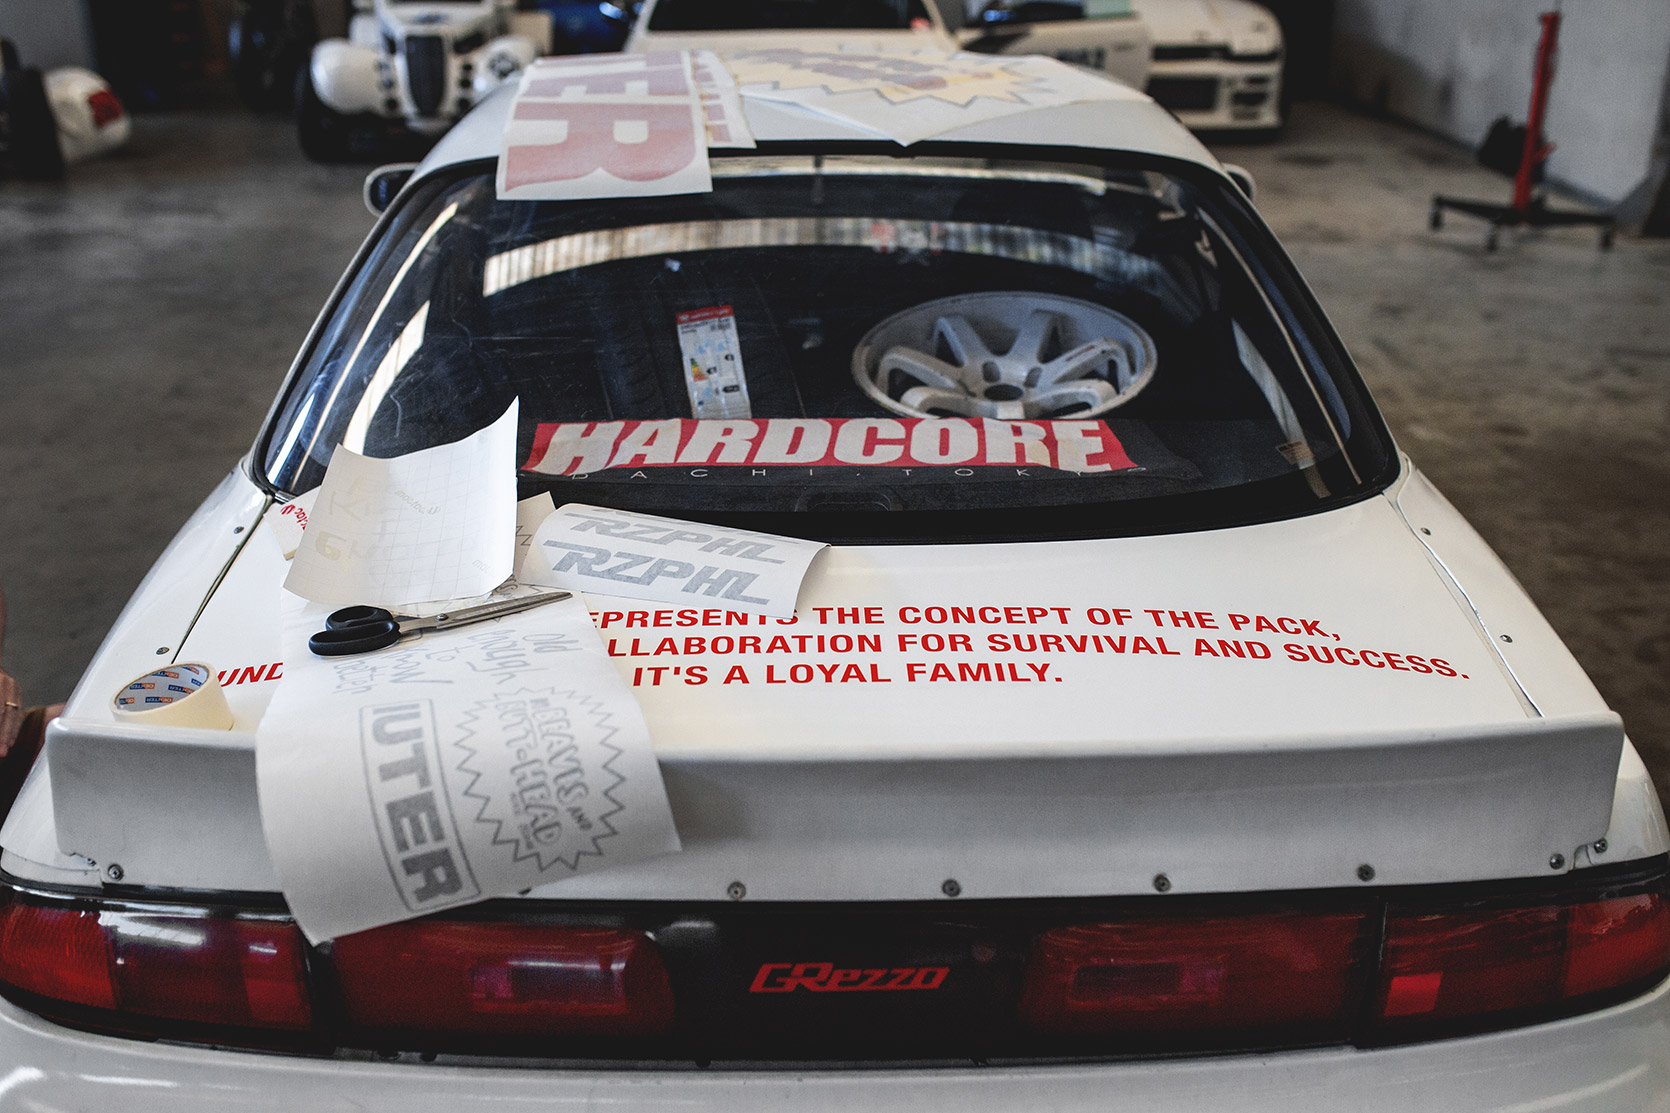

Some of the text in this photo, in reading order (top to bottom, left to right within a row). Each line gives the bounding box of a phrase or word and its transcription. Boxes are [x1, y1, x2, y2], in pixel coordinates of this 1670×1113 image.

[531, 417, 1112, 475] HARDCORE
[564, 512, 786, 565] RZPHL
[543, 540, 770, 606] RZPHL
[589, 606, 1341, 641] PRESEN THE CONCEPT OF THE PACK,
[632, 665, 708, 686] IT'S
[723, 665, 750, 685] A
[766, 663, 892, 684] LOYAL
[906, 662, 1063, 682] FAMILY.
[898, 634, 974, 652] FOR
[988, 634, 1181, 656] SURVIVAL
[1194, 638, 1272, 660] AND
[1283, 643, 1470, 680] SUCCESS.
[372, 702, 463, 903] IUTER
